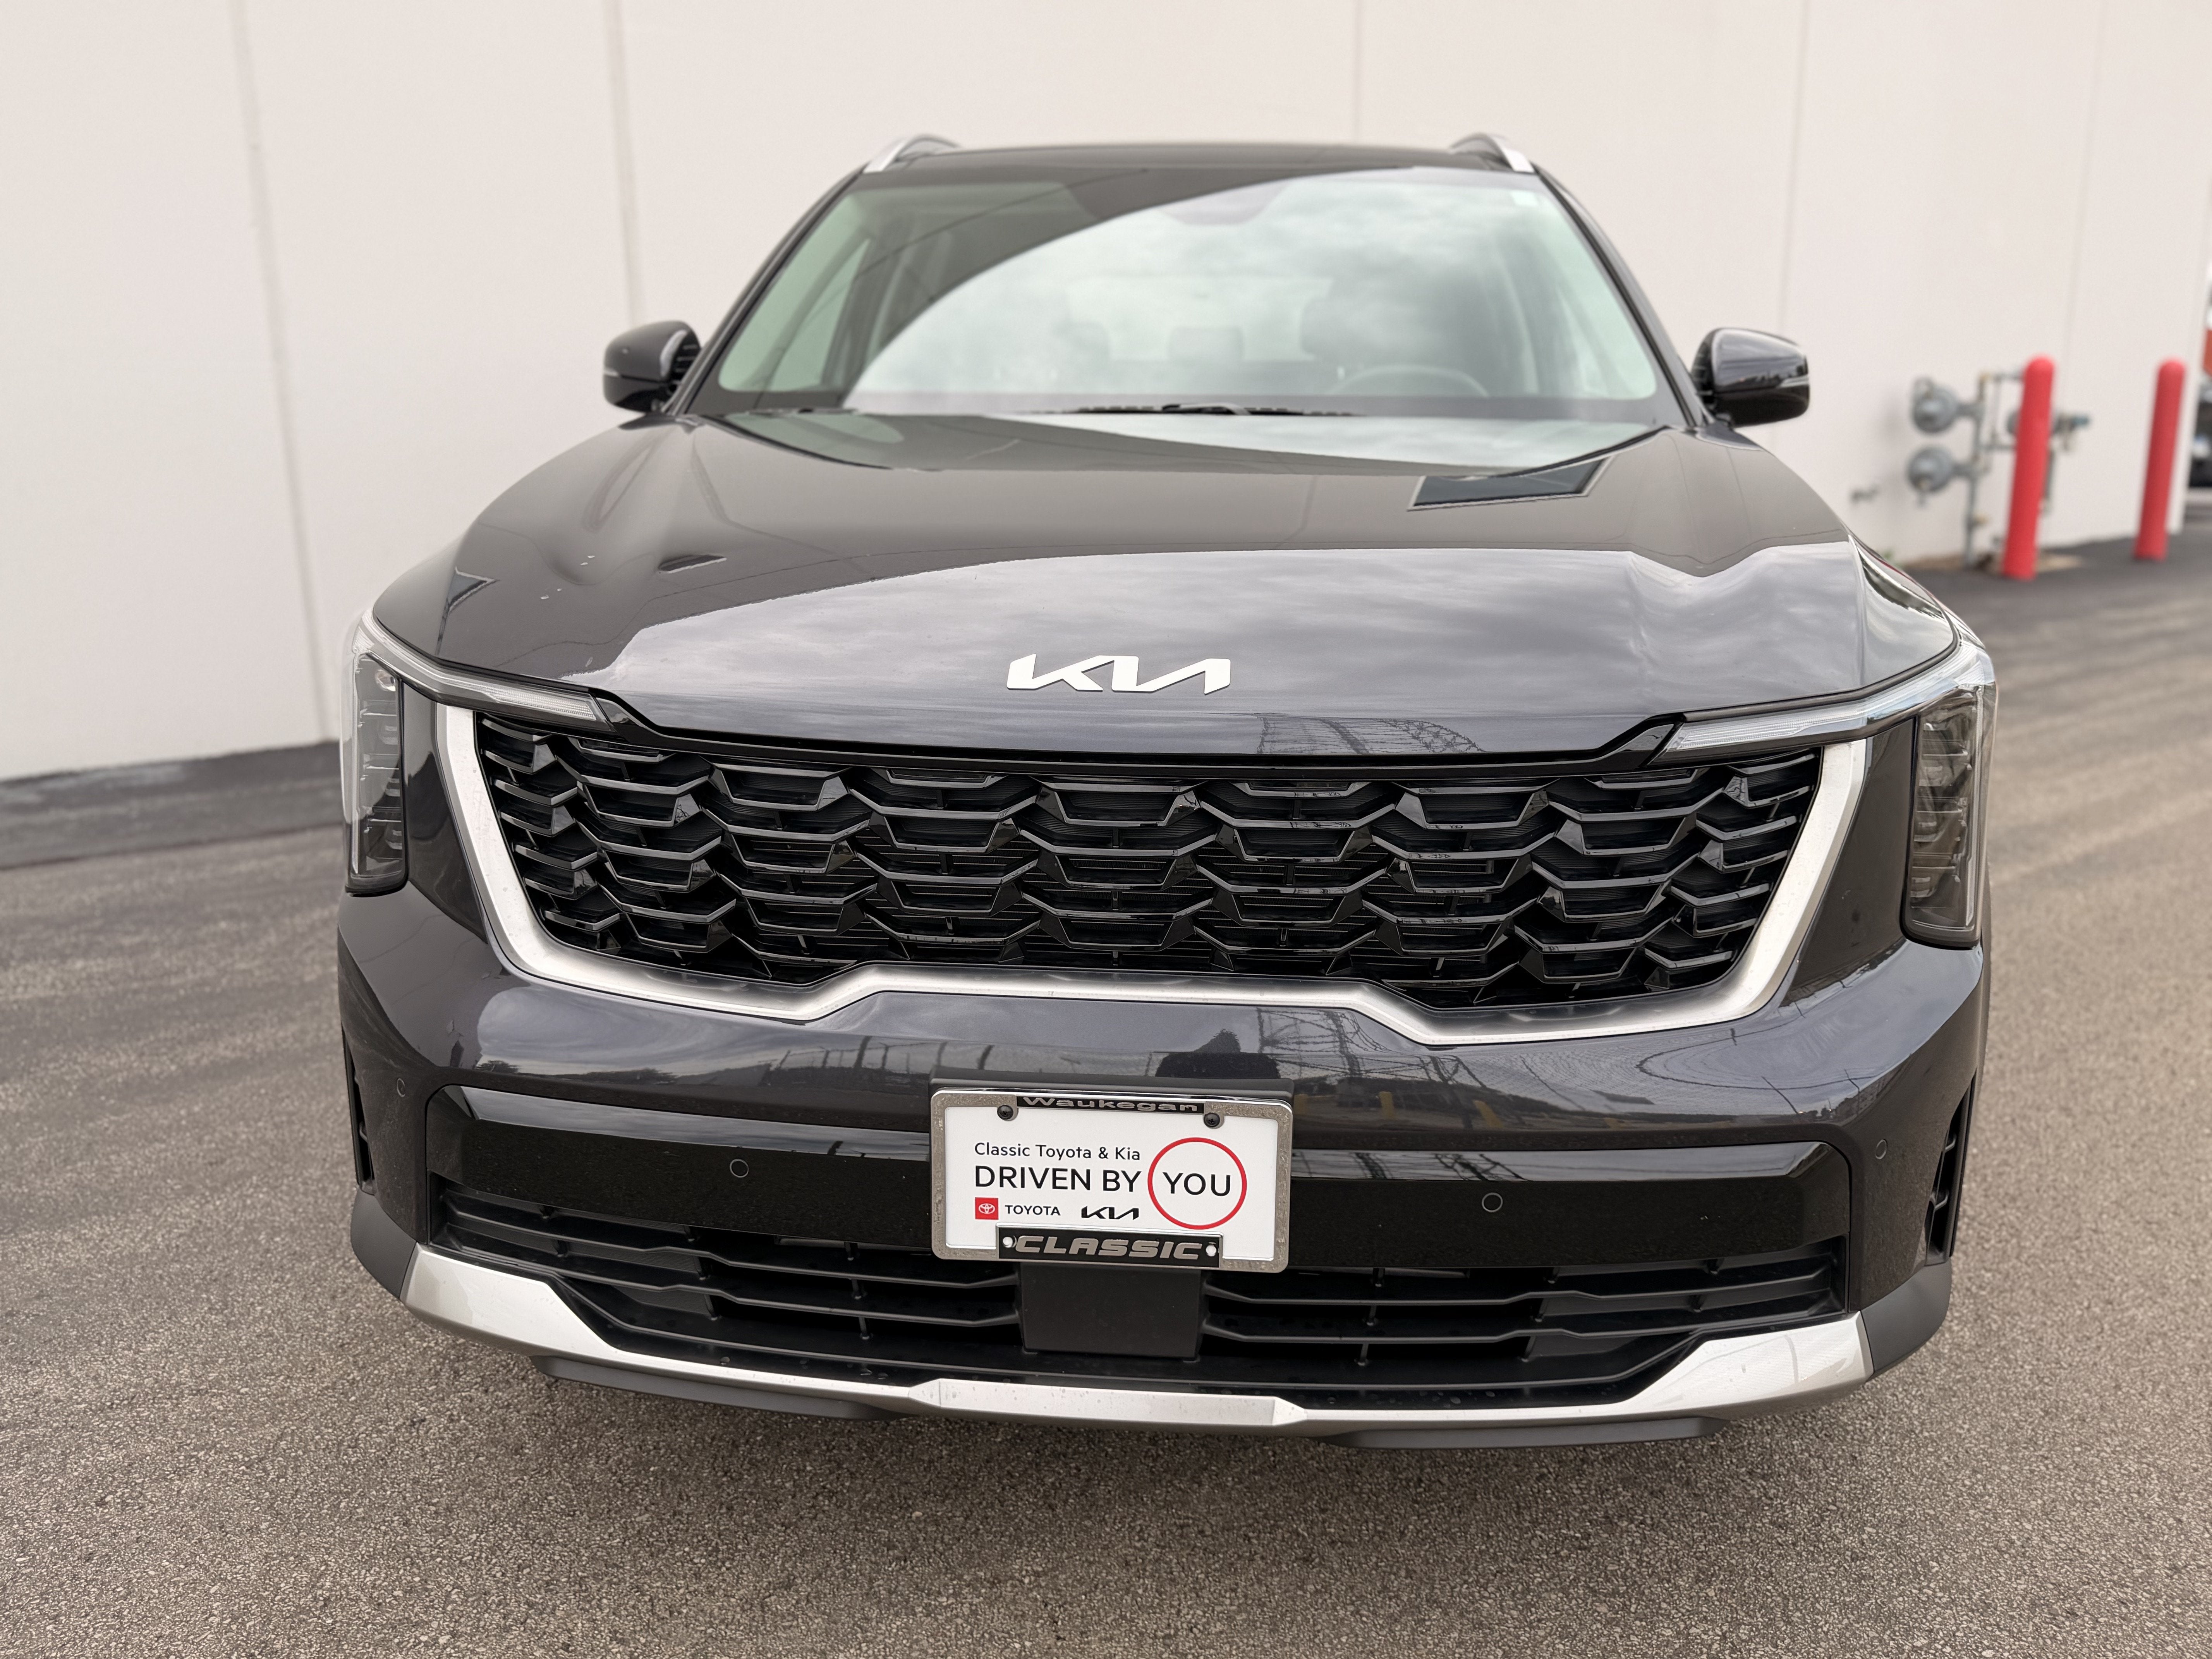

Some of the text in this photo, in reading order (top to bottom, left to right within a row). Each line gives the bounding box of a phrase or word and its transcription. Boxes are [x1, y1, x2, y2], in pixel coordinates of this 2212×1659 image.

[1007, 653, 1231, 694] KIA
[1023, 1097, 1198, 1111] Waukegan
[974, 1142, 1140, 1160] Classic Toyota & Kia
[975, 1166, 1231, 1196] DRIVEN BY YOU
[1005, 1205, 1061, 1216] TOYOTA
[1081, 1206, 1139, 1220] KIA
[1015, 1236, 1202, 1259] CLASSIC
